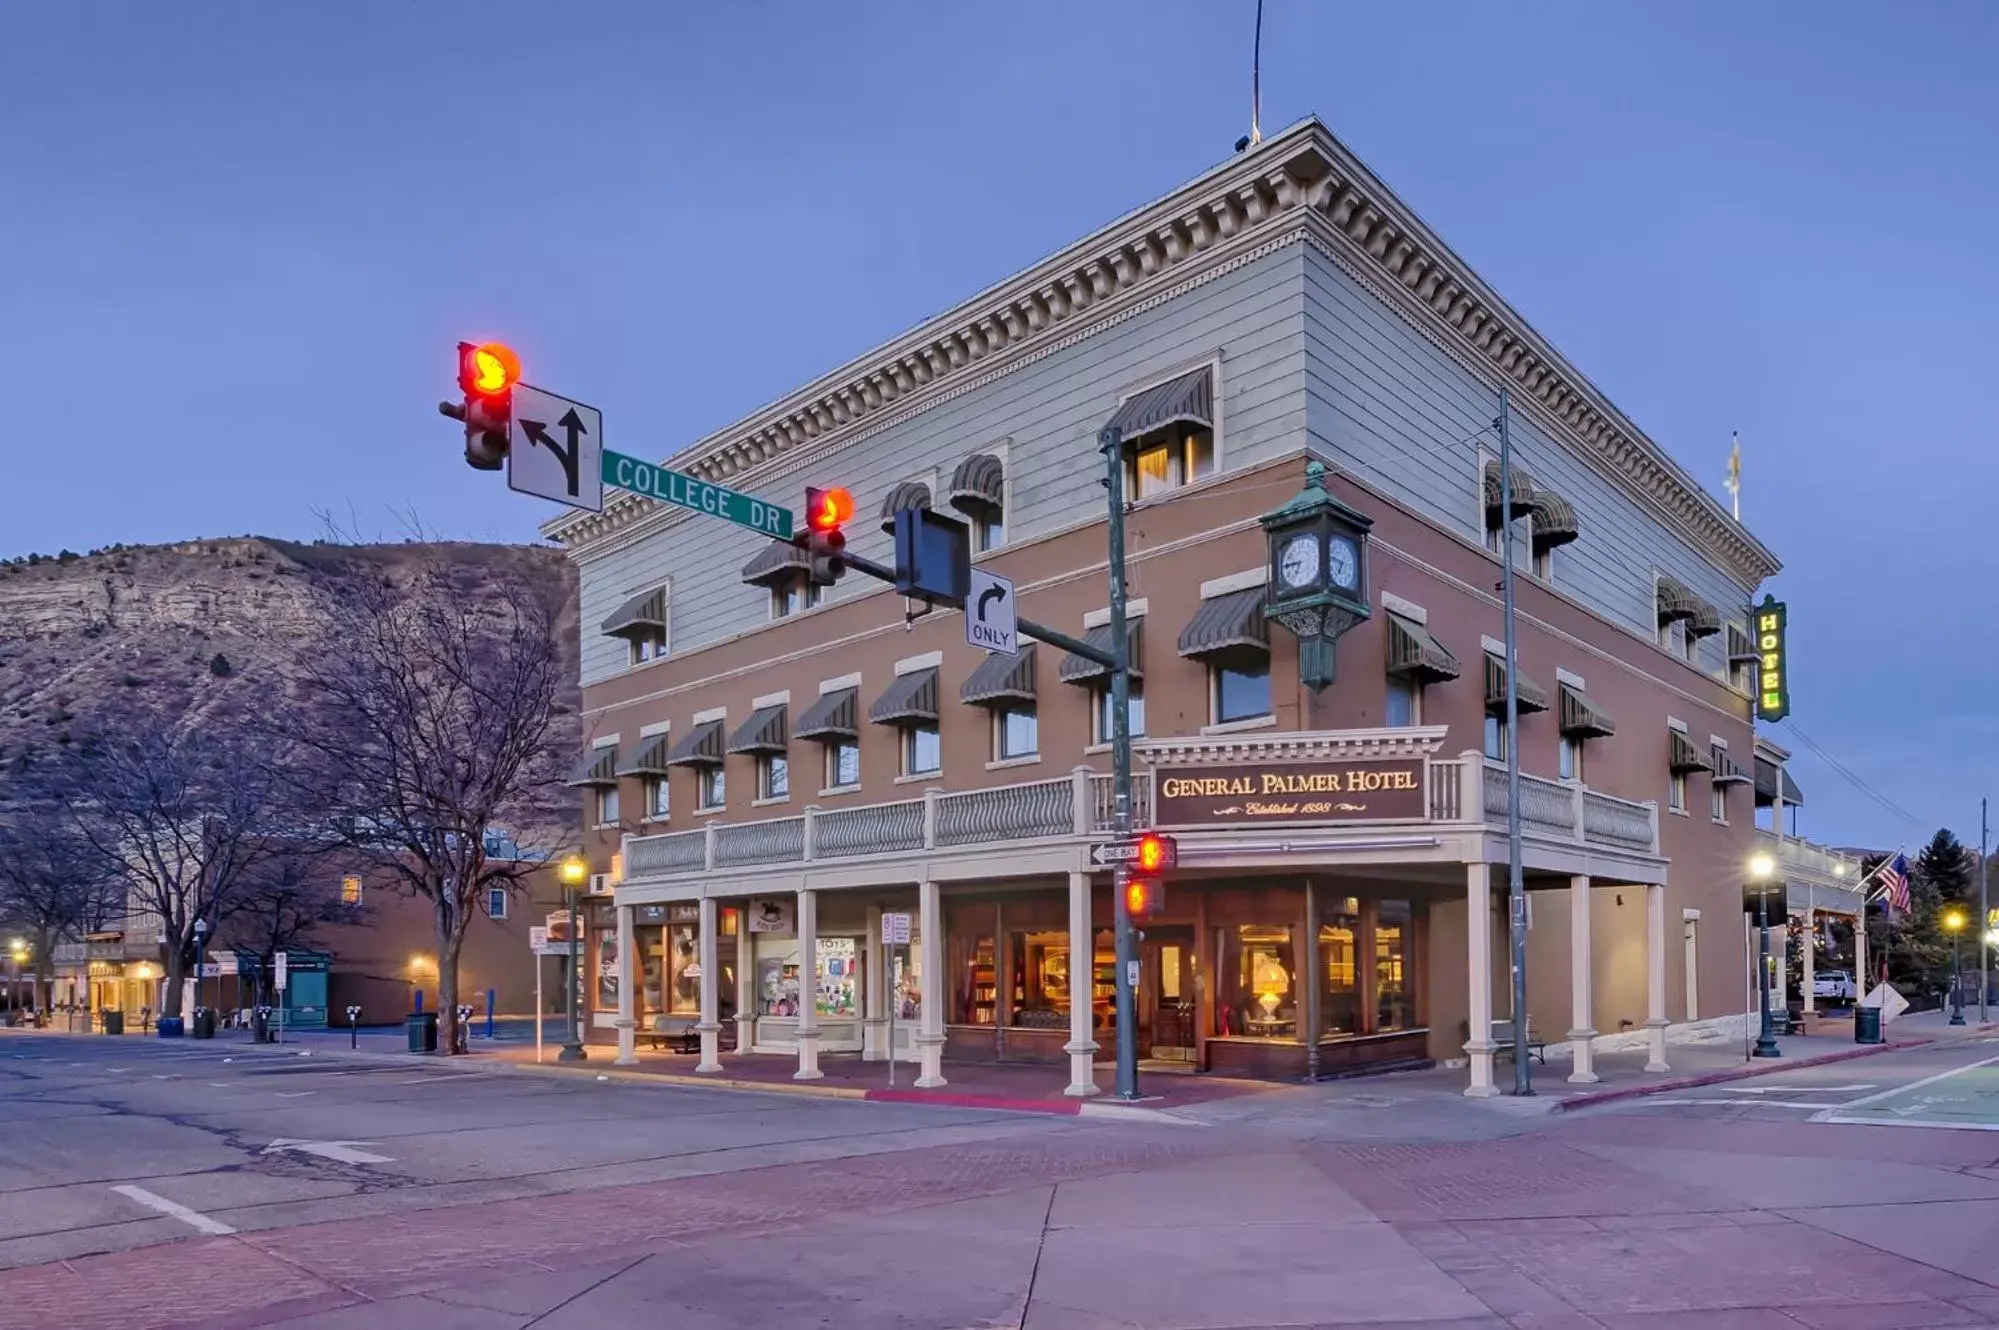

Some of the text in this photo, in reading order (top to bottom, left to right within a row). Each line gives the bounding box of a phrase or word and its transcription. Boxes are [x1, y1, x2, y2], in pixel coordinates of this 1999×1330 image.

[616, 458, 780, 533] COLLEGE DR
[973, 624, 1009, 647] ONLY
[1760, 613, 1780, 709] HOTEL
[1162, 770, 1418, 798] GENERAL PALMER HOTEL
[1245, 801, 1332, 815] Established 1898
[1104, 847, 1137, 858] ONE WAY
[821, 940, 846, 949] TOYS
